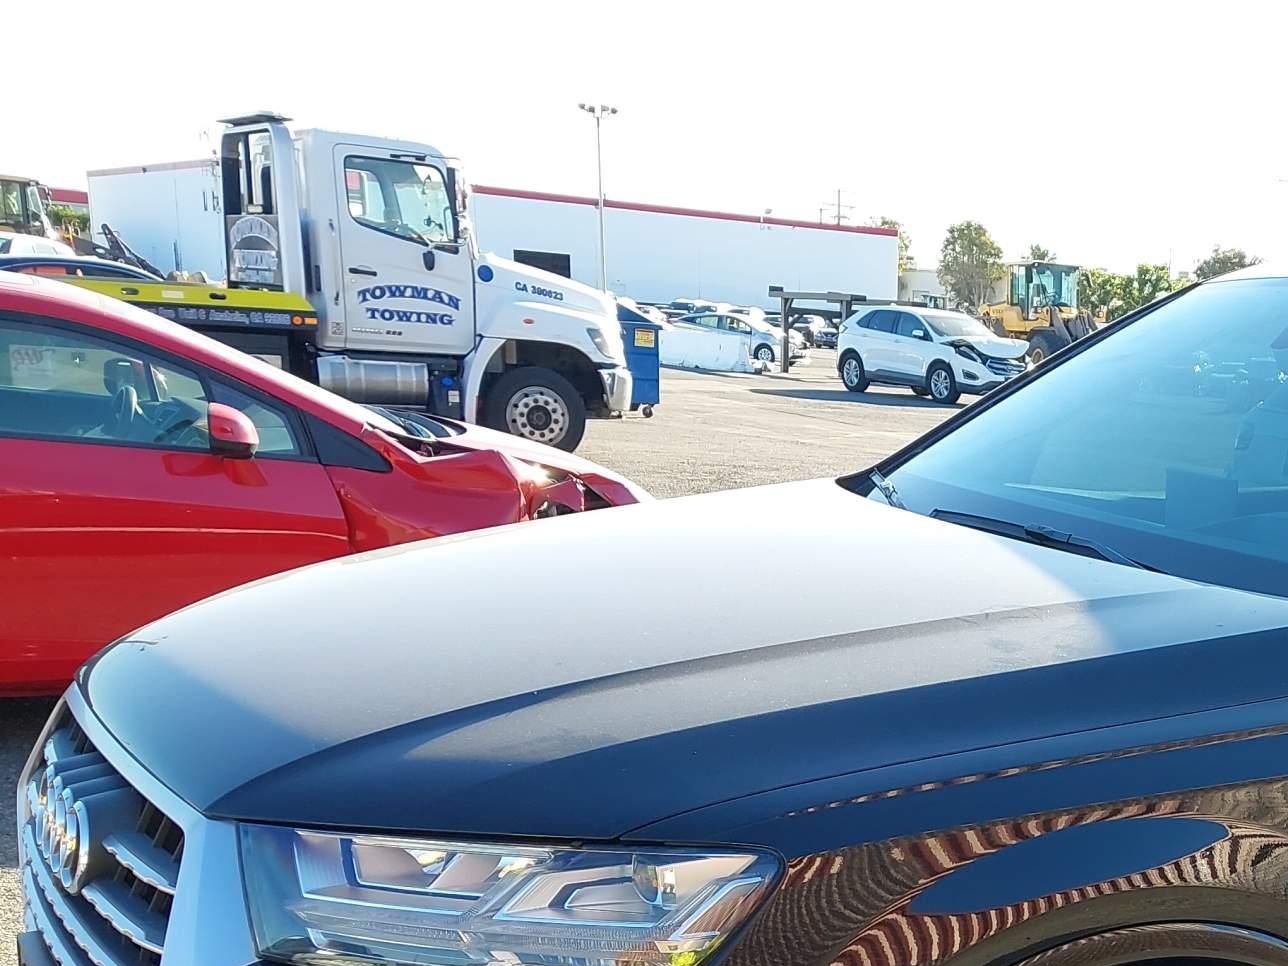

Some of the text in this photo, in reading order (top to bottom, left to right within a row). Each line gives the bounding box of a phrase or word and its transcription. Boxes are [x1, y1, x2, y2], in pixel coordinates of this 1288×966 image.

[515, 281, 529, 293] CA
[357, 284, 462, 311] TOWMAN
[365, 307, 457, 326] TOWING
